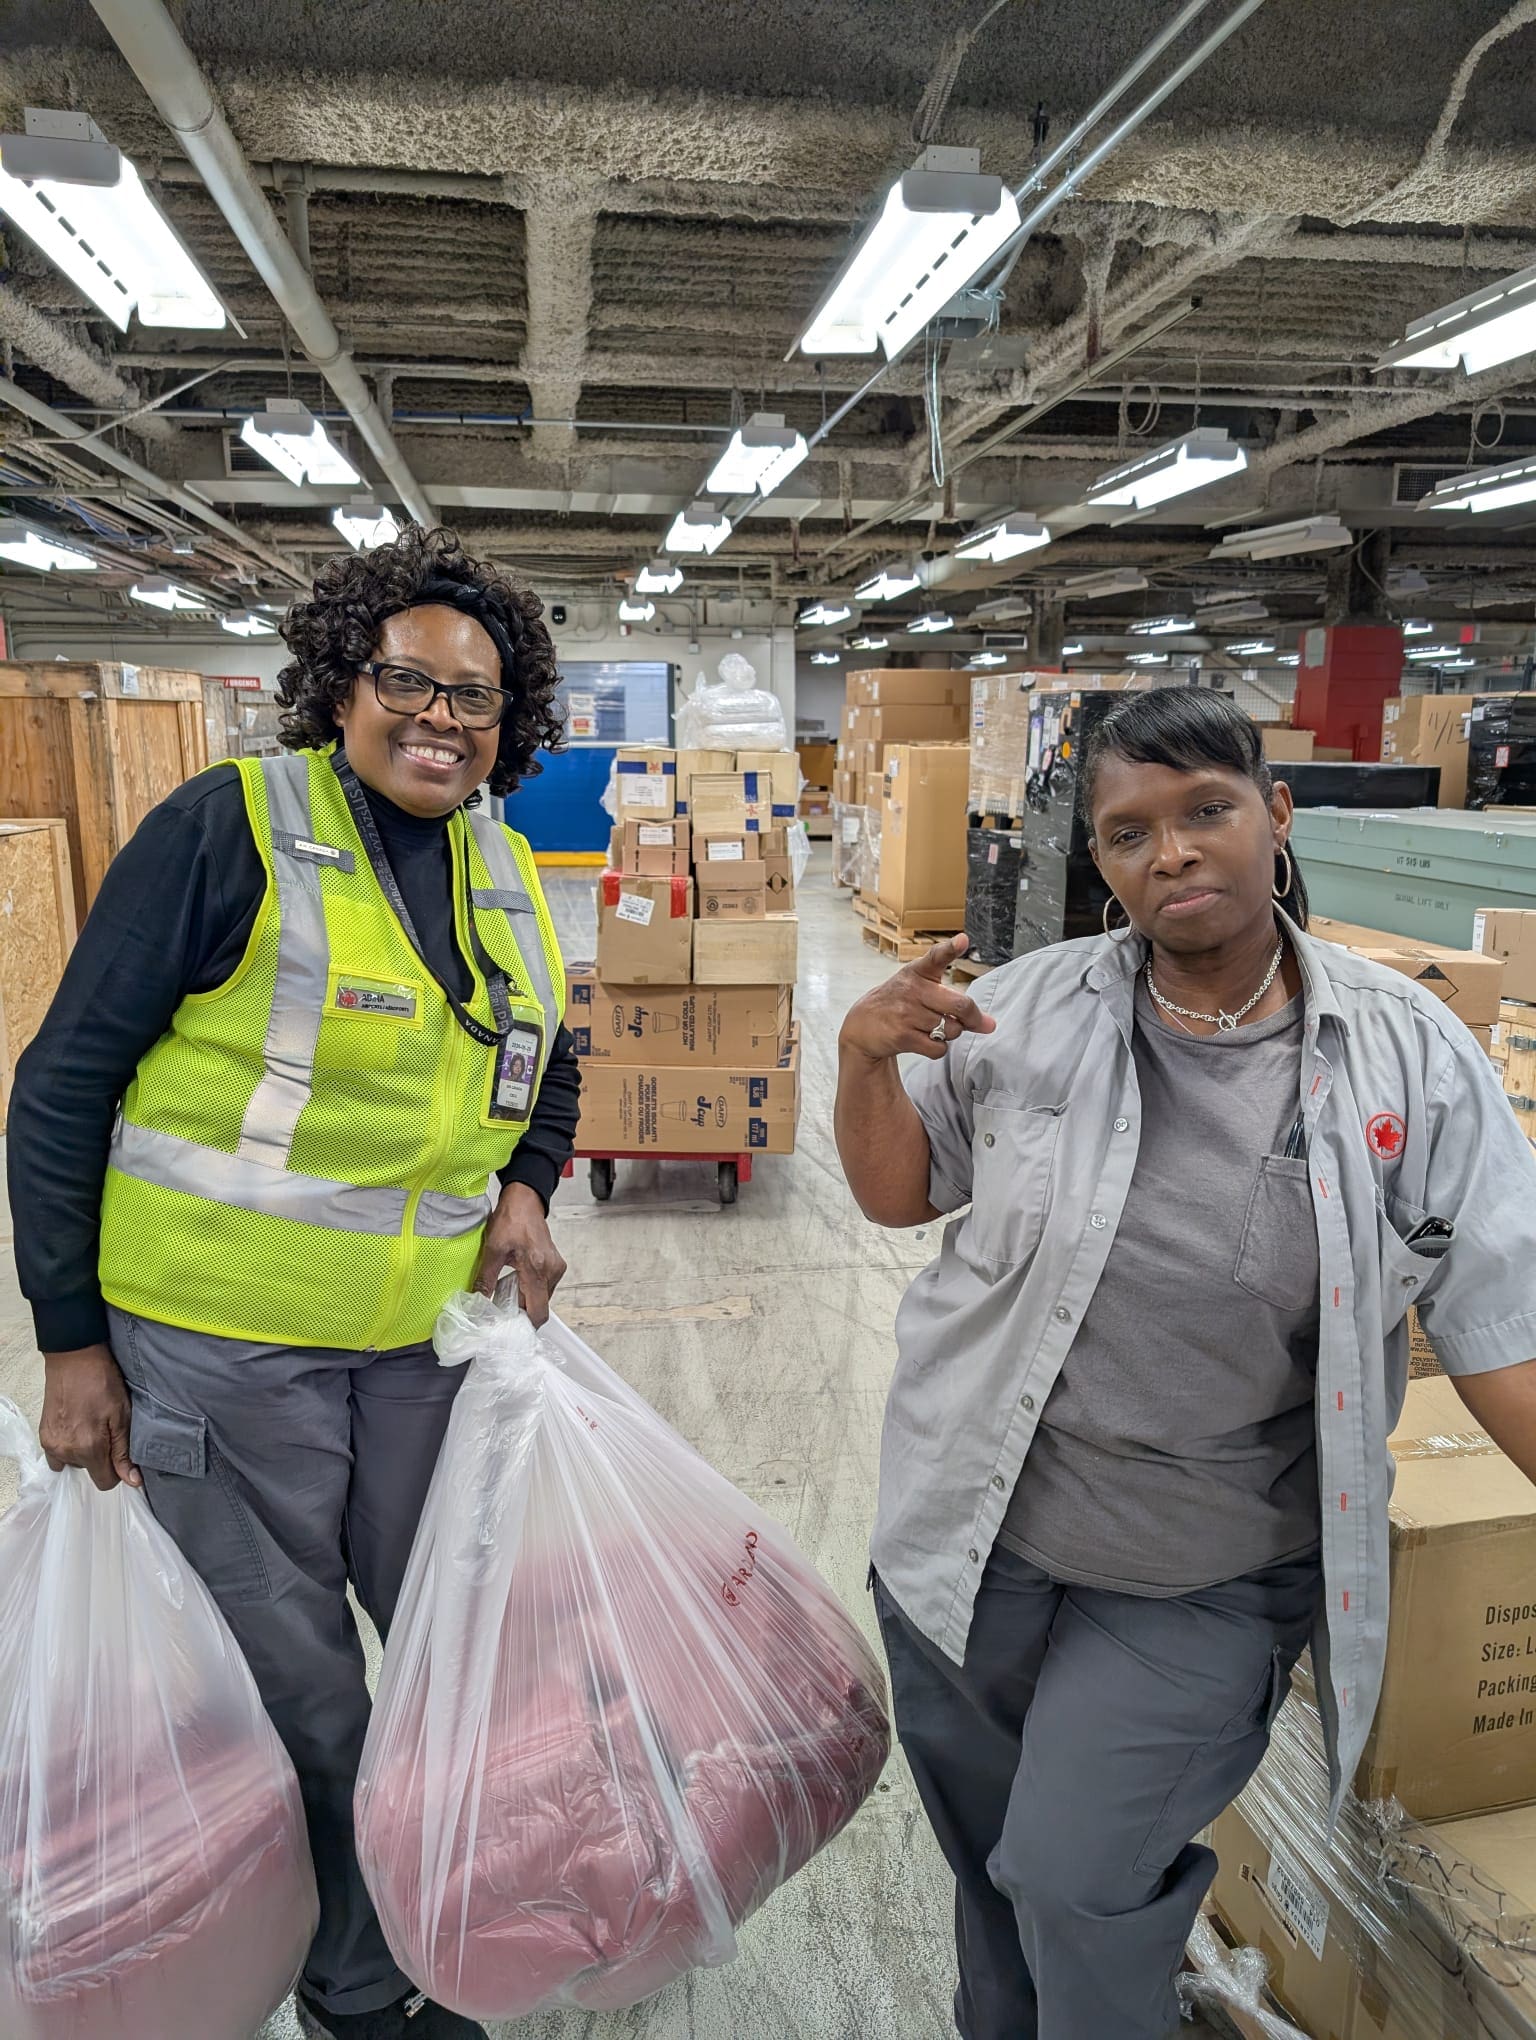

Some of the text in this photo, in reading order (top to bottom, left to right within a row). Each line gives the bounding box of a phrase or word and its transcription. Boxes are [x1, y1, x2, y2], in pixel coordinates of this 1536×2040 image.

[1481, 1641, 1521, 1663] Size:
[1477, 1673, 1536, 1699] Packing
[1472, 1707, 1533, 1735] Made In
